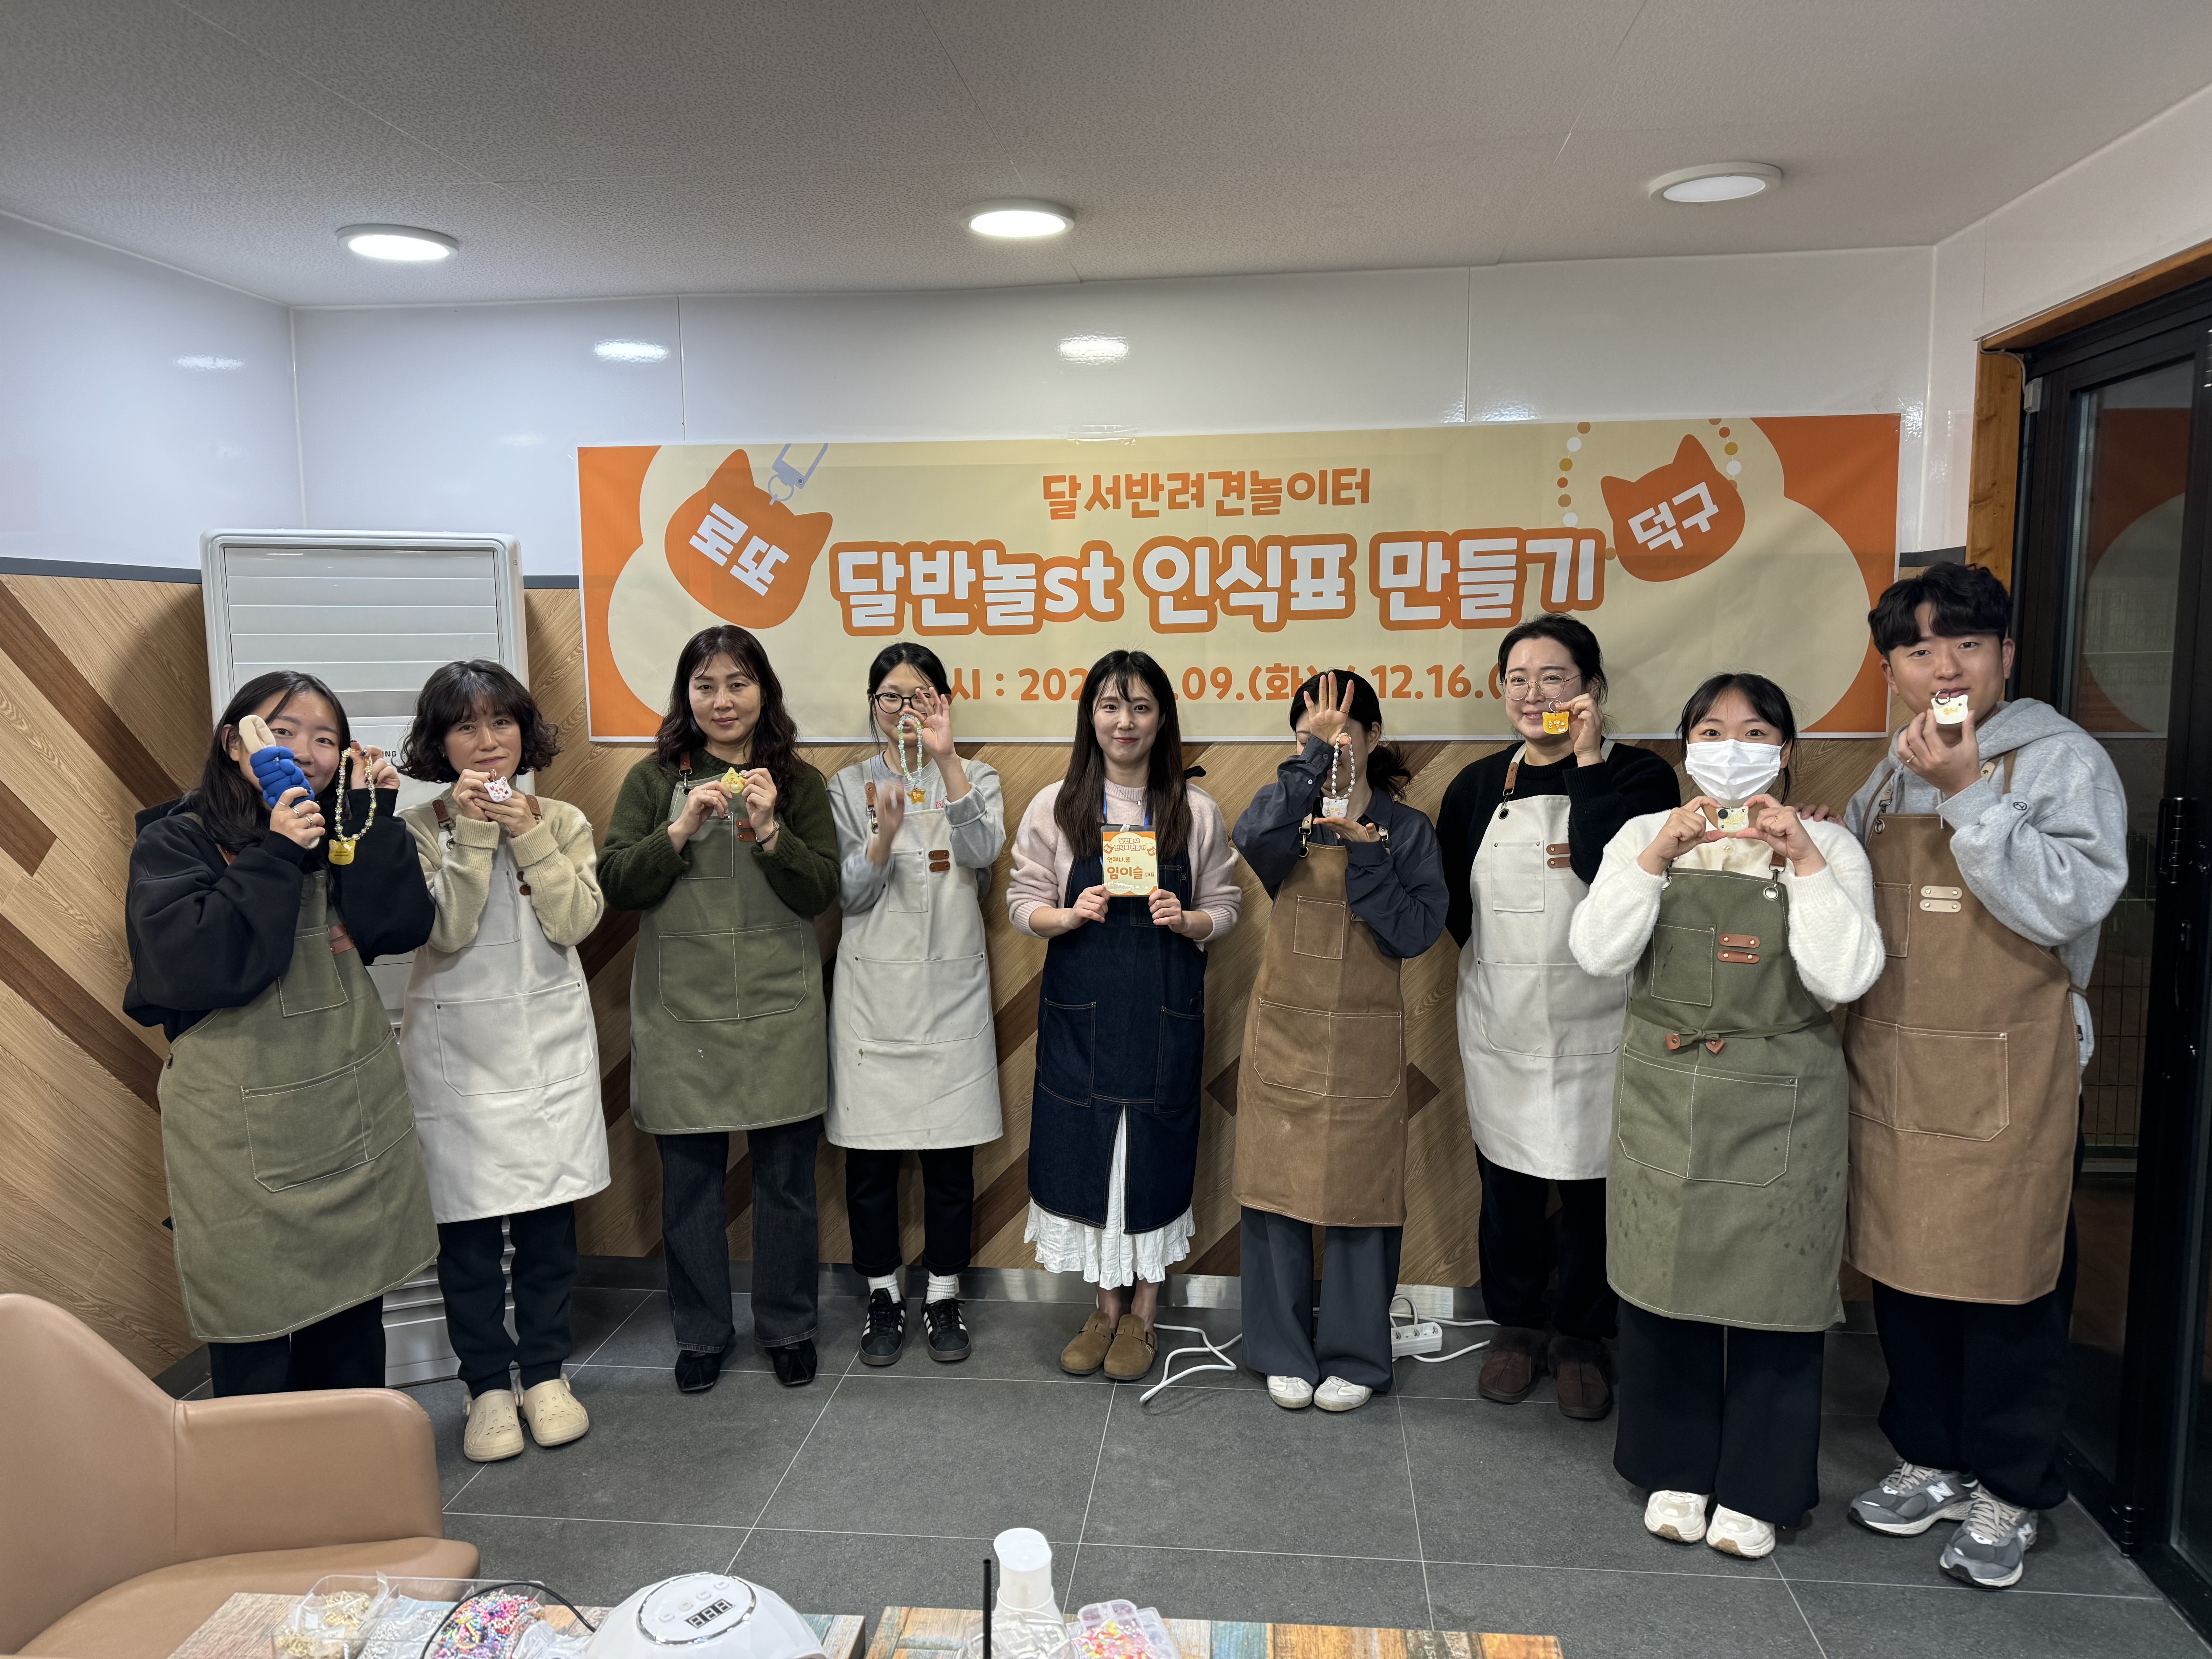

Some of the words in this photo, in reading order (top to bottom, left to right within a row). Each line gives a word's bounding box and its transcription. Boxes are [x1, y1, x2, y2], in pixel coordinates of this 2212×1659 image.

[1042, 467, 1370, 520] 달서반려견놀이터
[1628, 481, 1719, 551] 덕구
[689, 503, 790, 598] 로또
[836, 547, 1117, 629] 달반놀st
[1139, 542, 1349, 625] 인식표
[1376, 536, 1598, 623] 만들기
[1107, 866, 1143, 880] 임이슬
